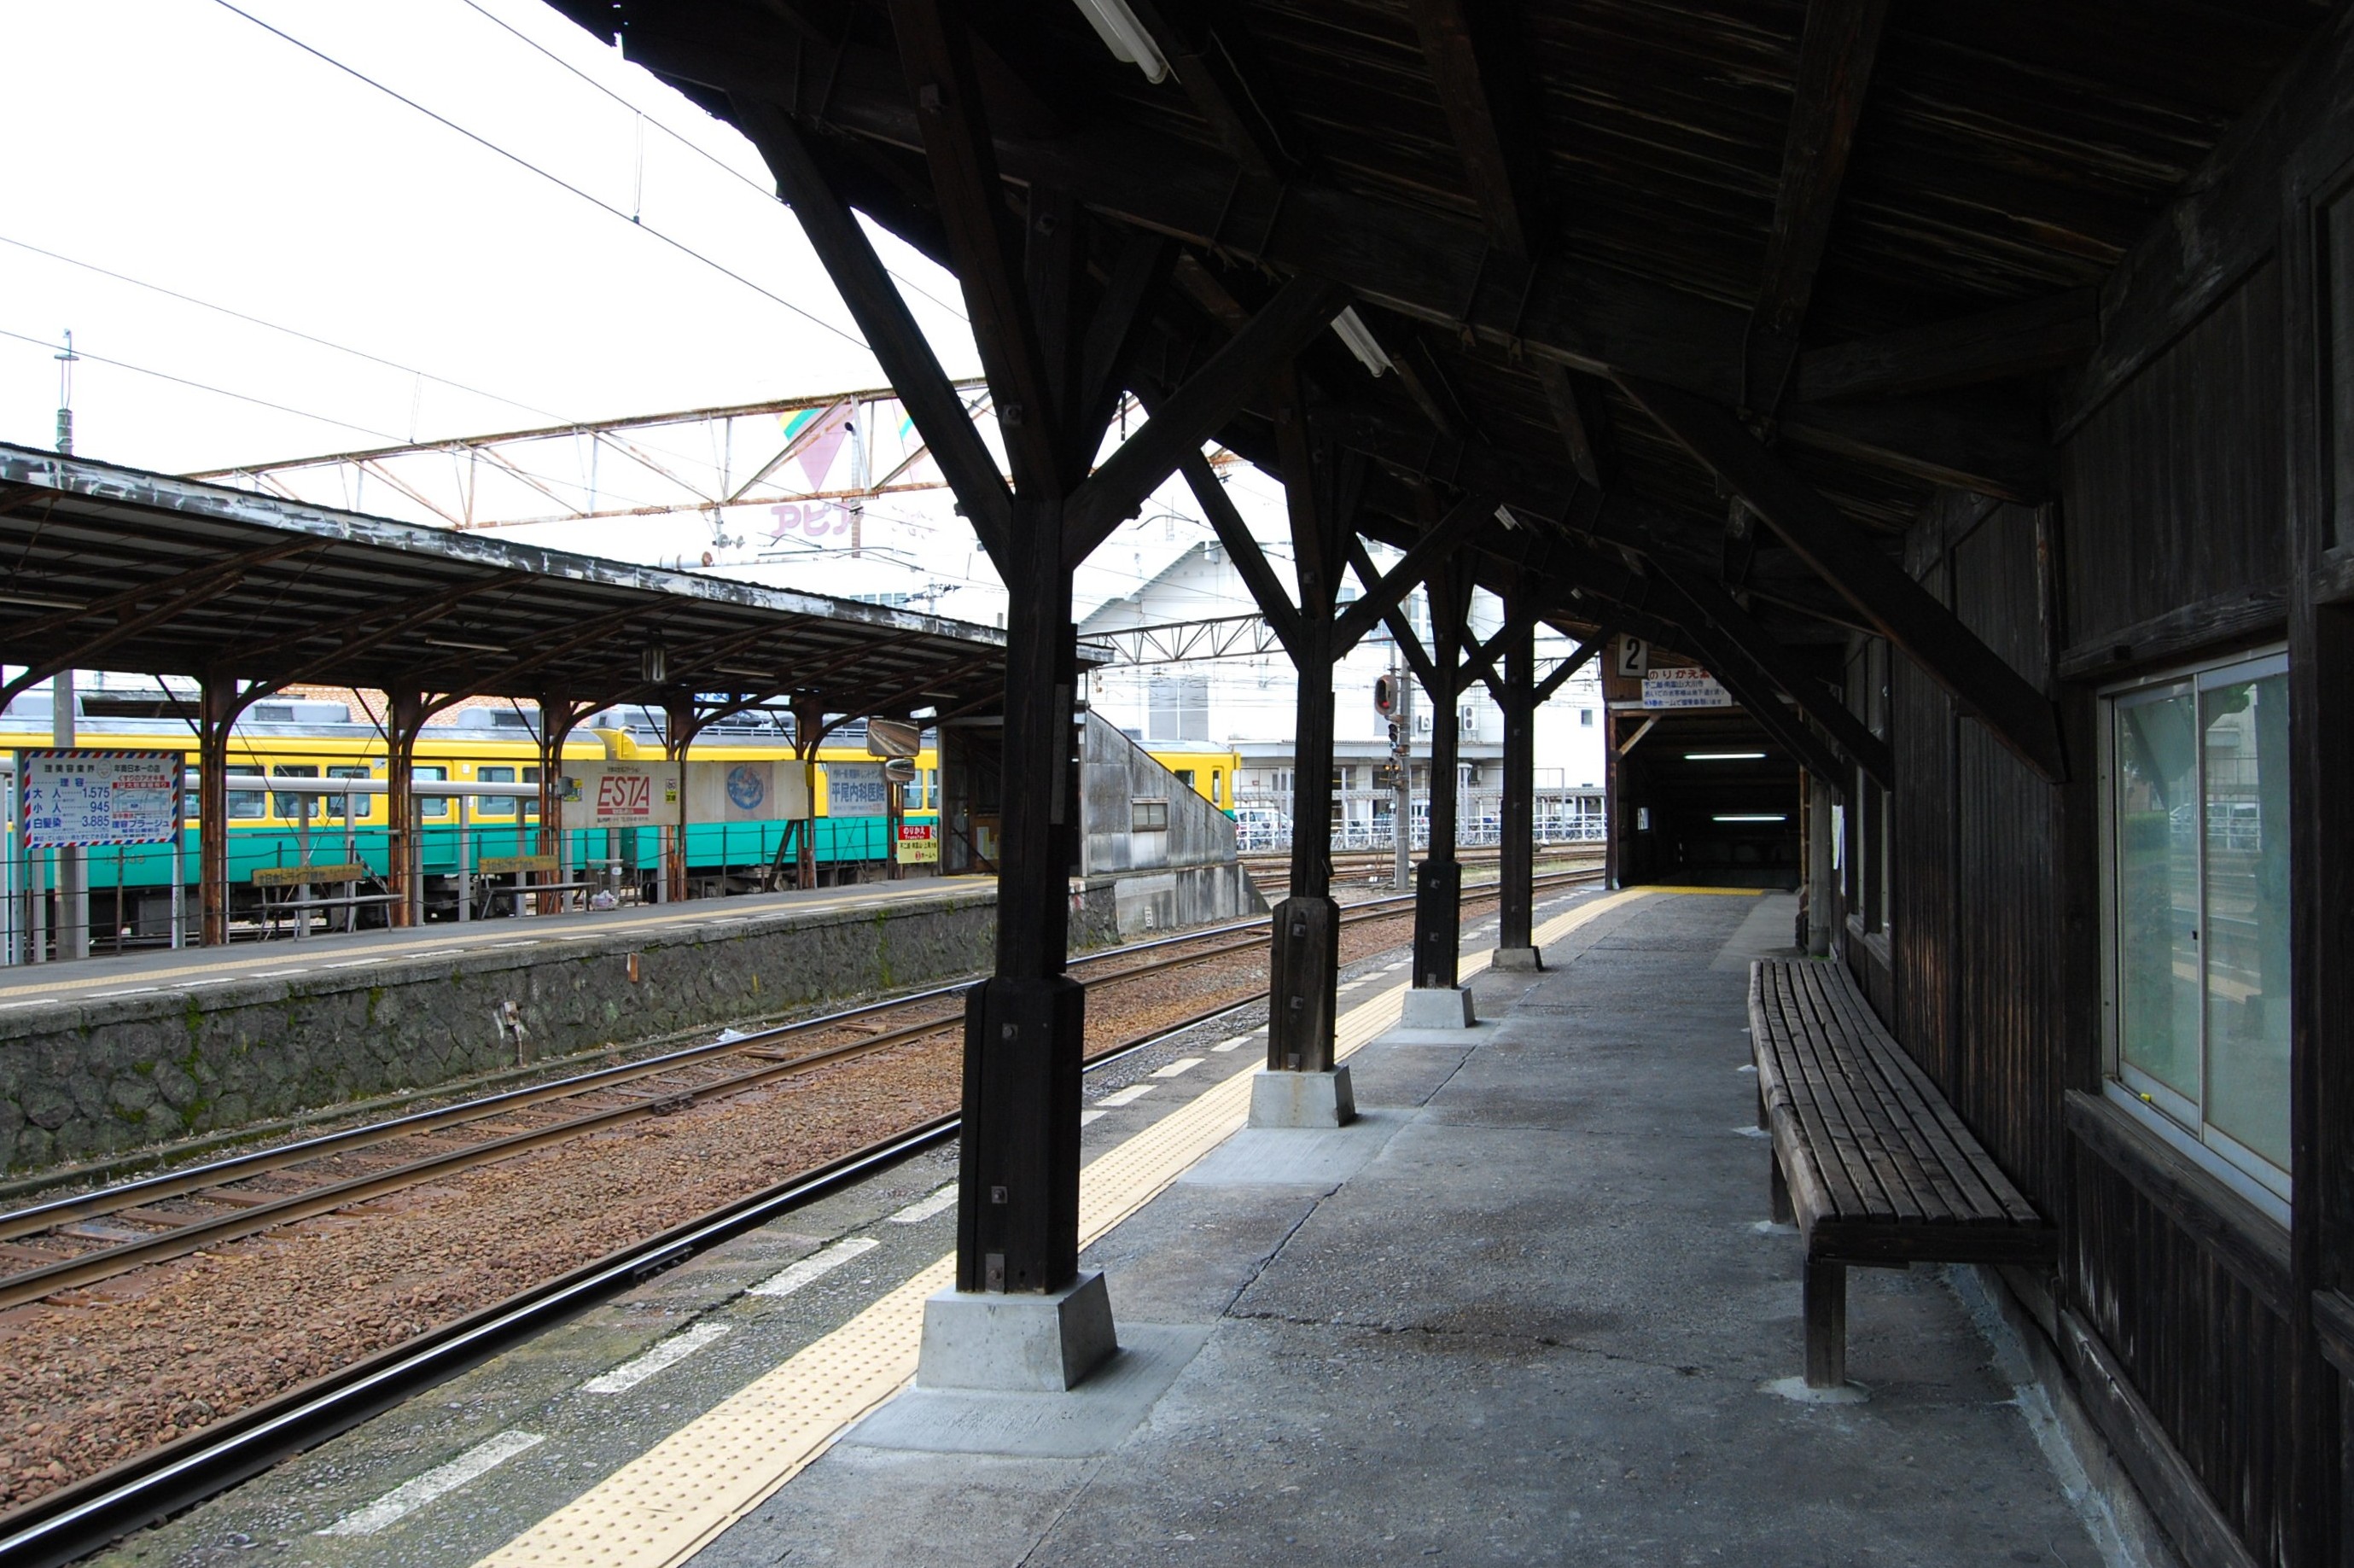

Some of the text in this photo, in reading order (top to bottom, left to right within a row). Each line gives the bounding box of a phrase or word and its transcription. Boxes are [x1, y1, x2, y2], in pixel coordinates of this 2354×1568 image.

[1626, 638, 1640, 669] 2
[597, 775, 650, 807] ESTA
[90, 801, 110, 813] 945
